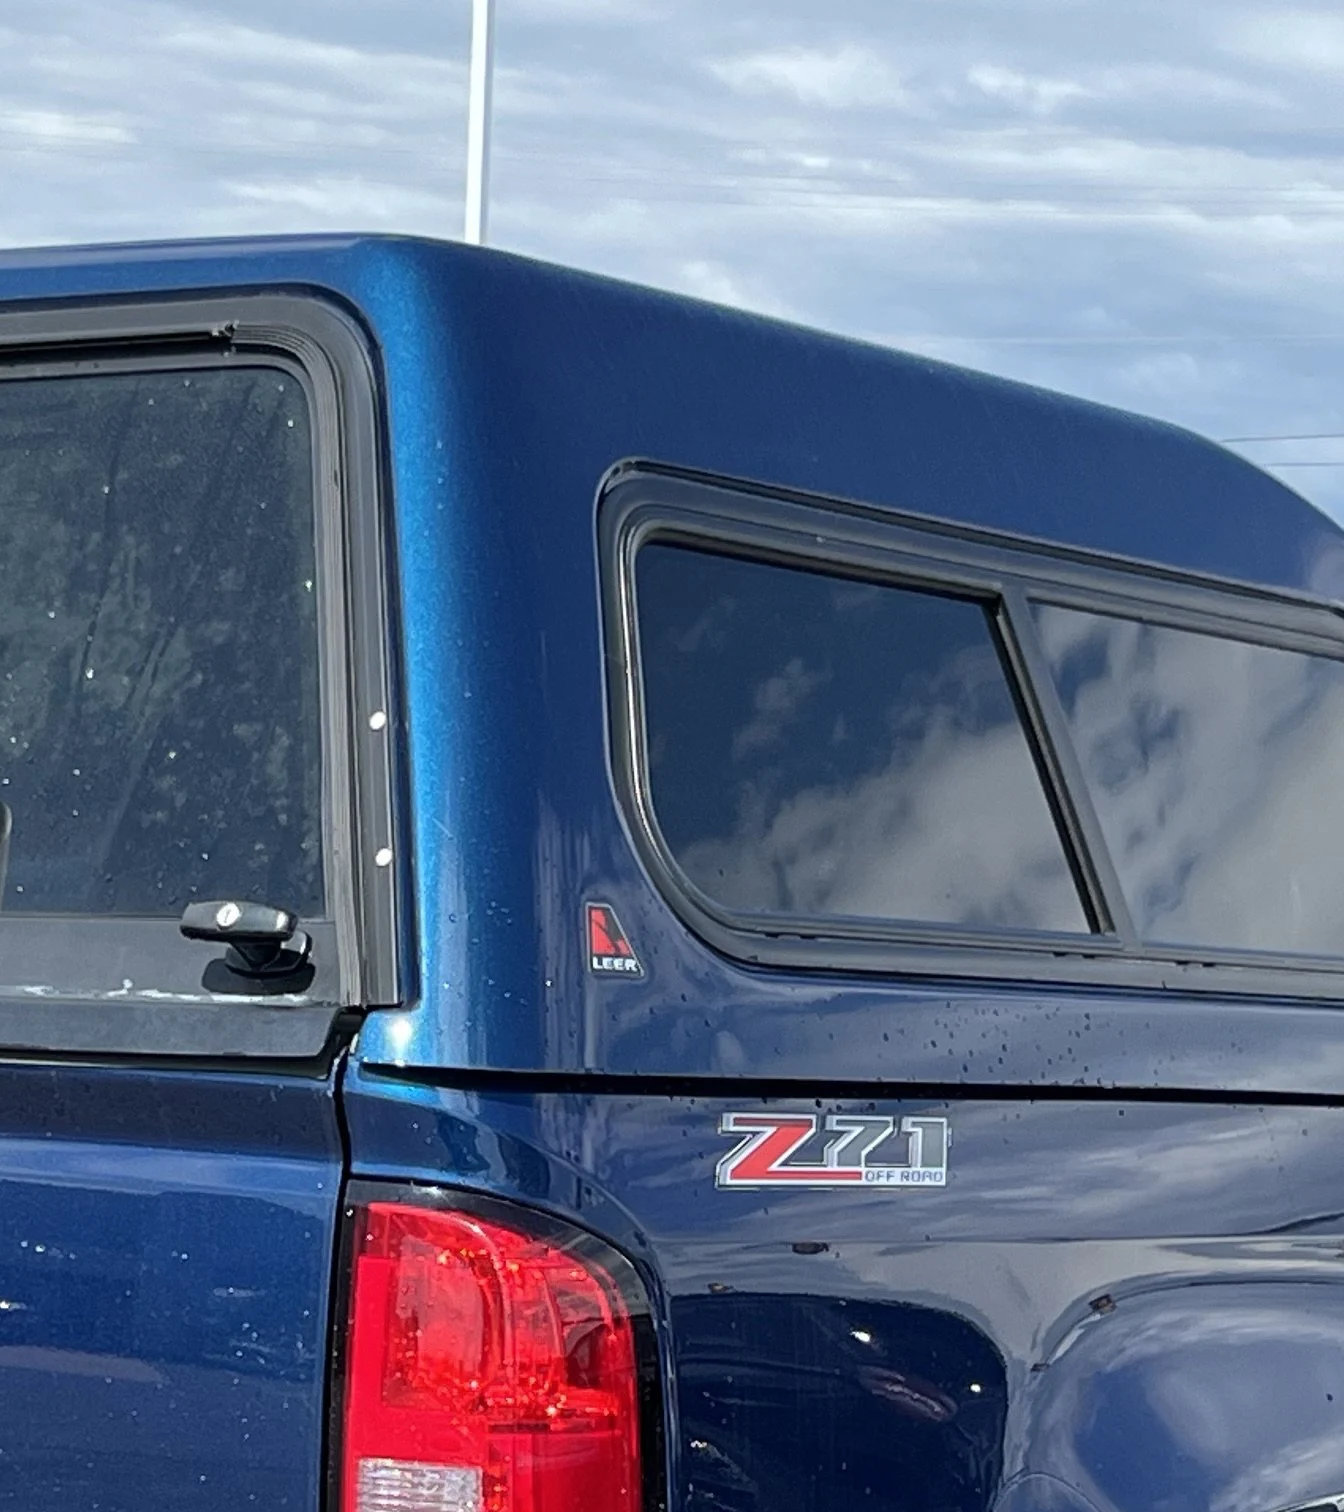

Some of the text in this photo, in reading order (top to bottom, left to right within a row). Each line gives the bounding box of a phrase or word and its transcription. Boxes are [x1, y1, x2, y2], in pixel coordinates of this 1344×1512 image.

[592, 956, 638, 972] LEER
[717, 1112, 948, 1187] Z71
[864, 1170, 944, 1183] OFF ROAD
